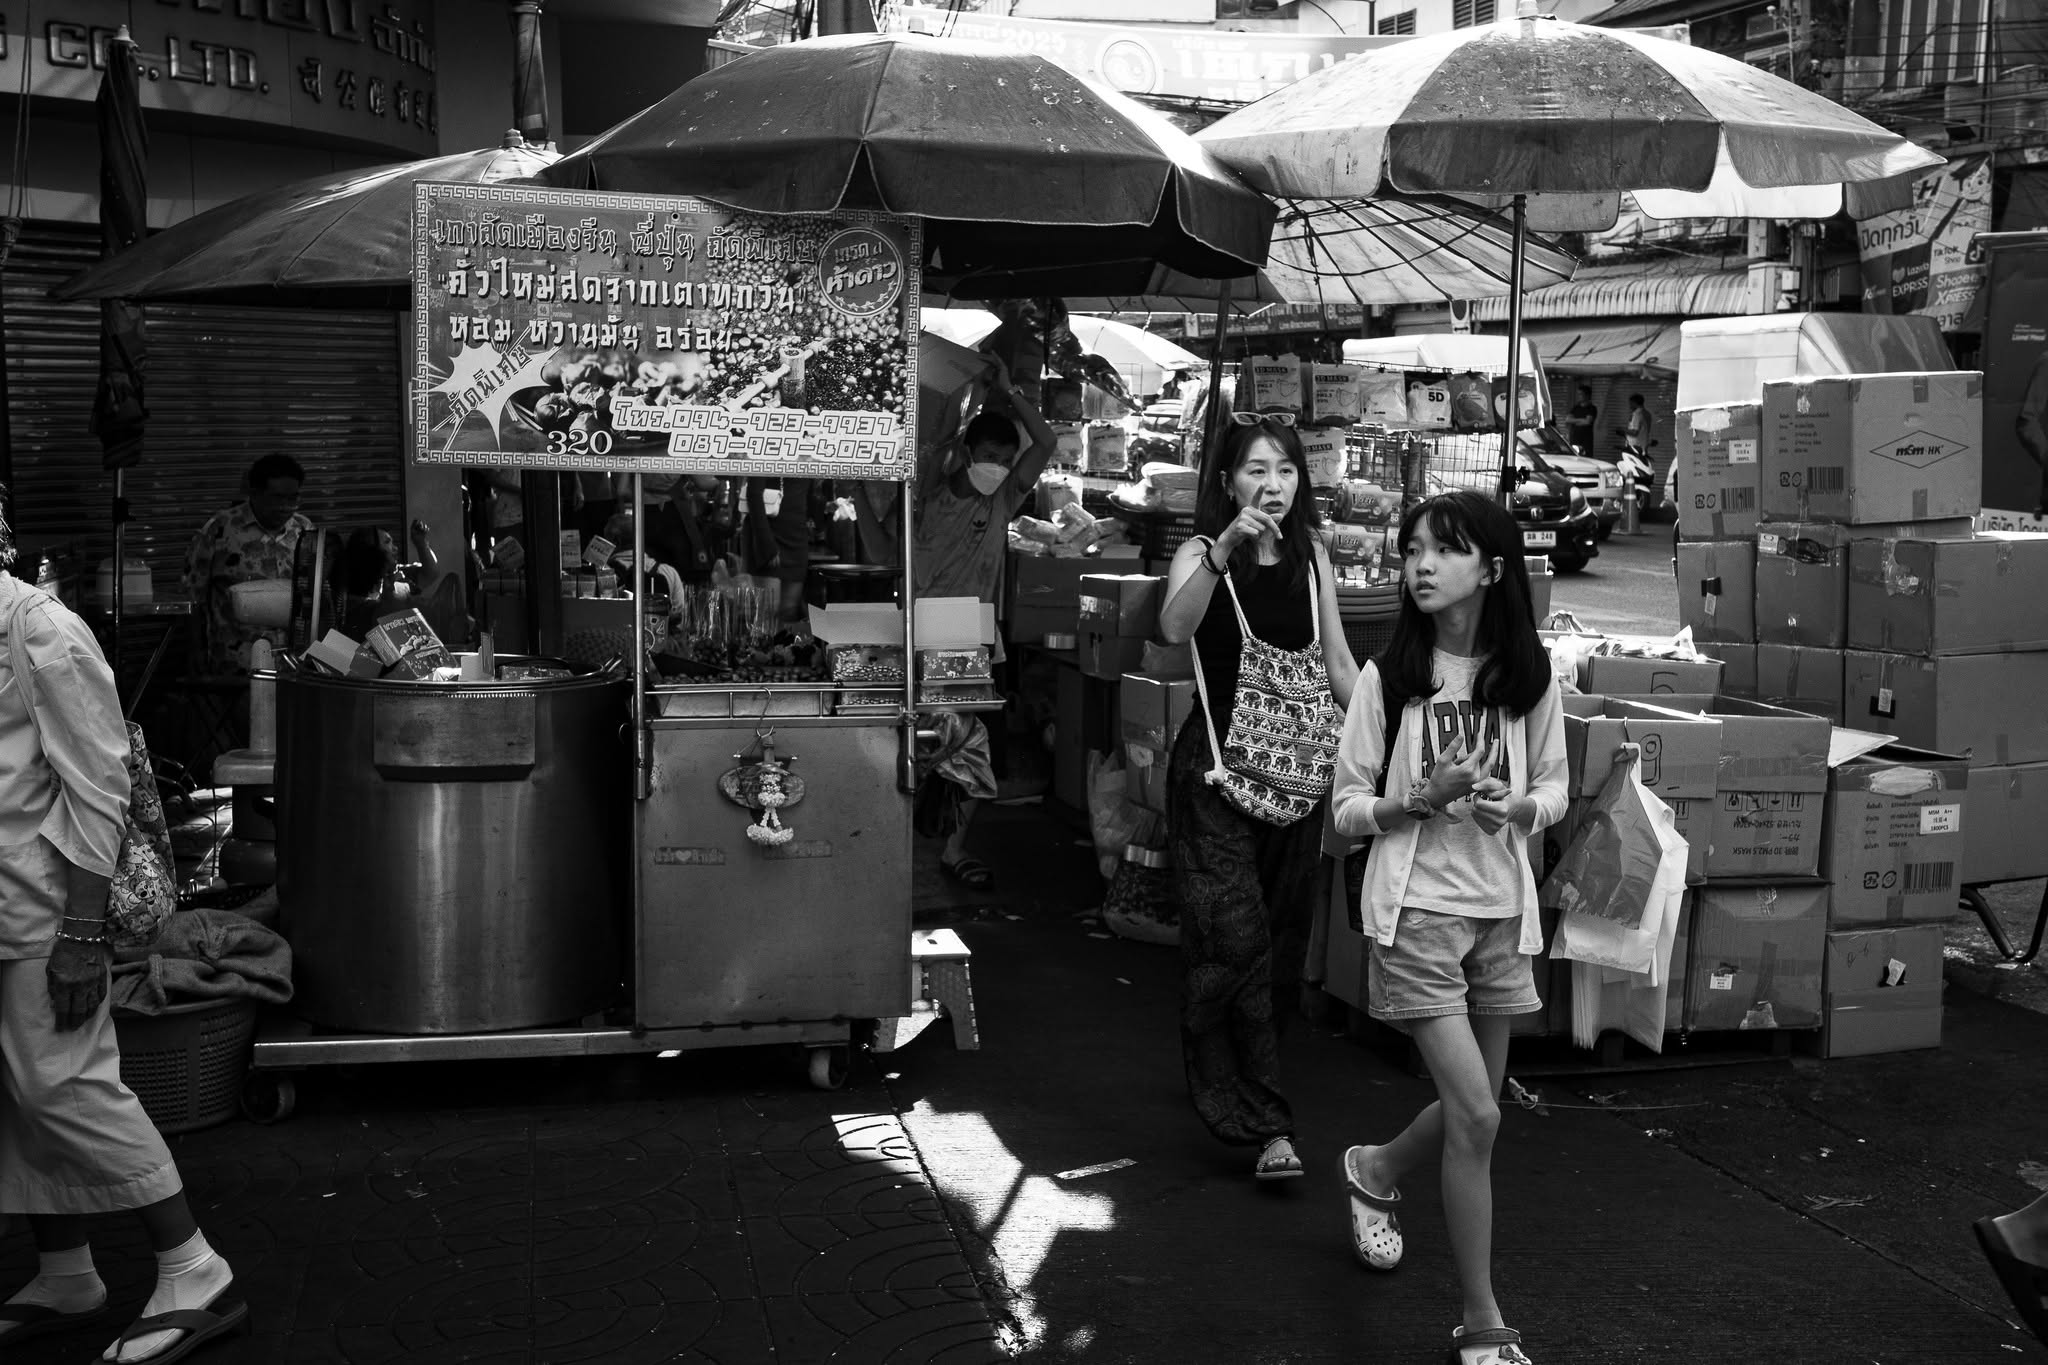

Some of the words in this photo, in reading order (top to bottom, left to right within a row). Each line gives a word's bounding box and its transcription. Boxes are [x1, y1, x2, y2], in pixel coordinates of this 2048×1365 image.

[630, 213, 695, 271] ญี่ปุ่น
[826, 261, 898, 295] ห้าดาว
[449, 315, 513, 345] หอม
[1428, 391, 1445, 403] 5D
[546, 428, 614, 457] 320
[1732, 847, 1752, 855] MASK
